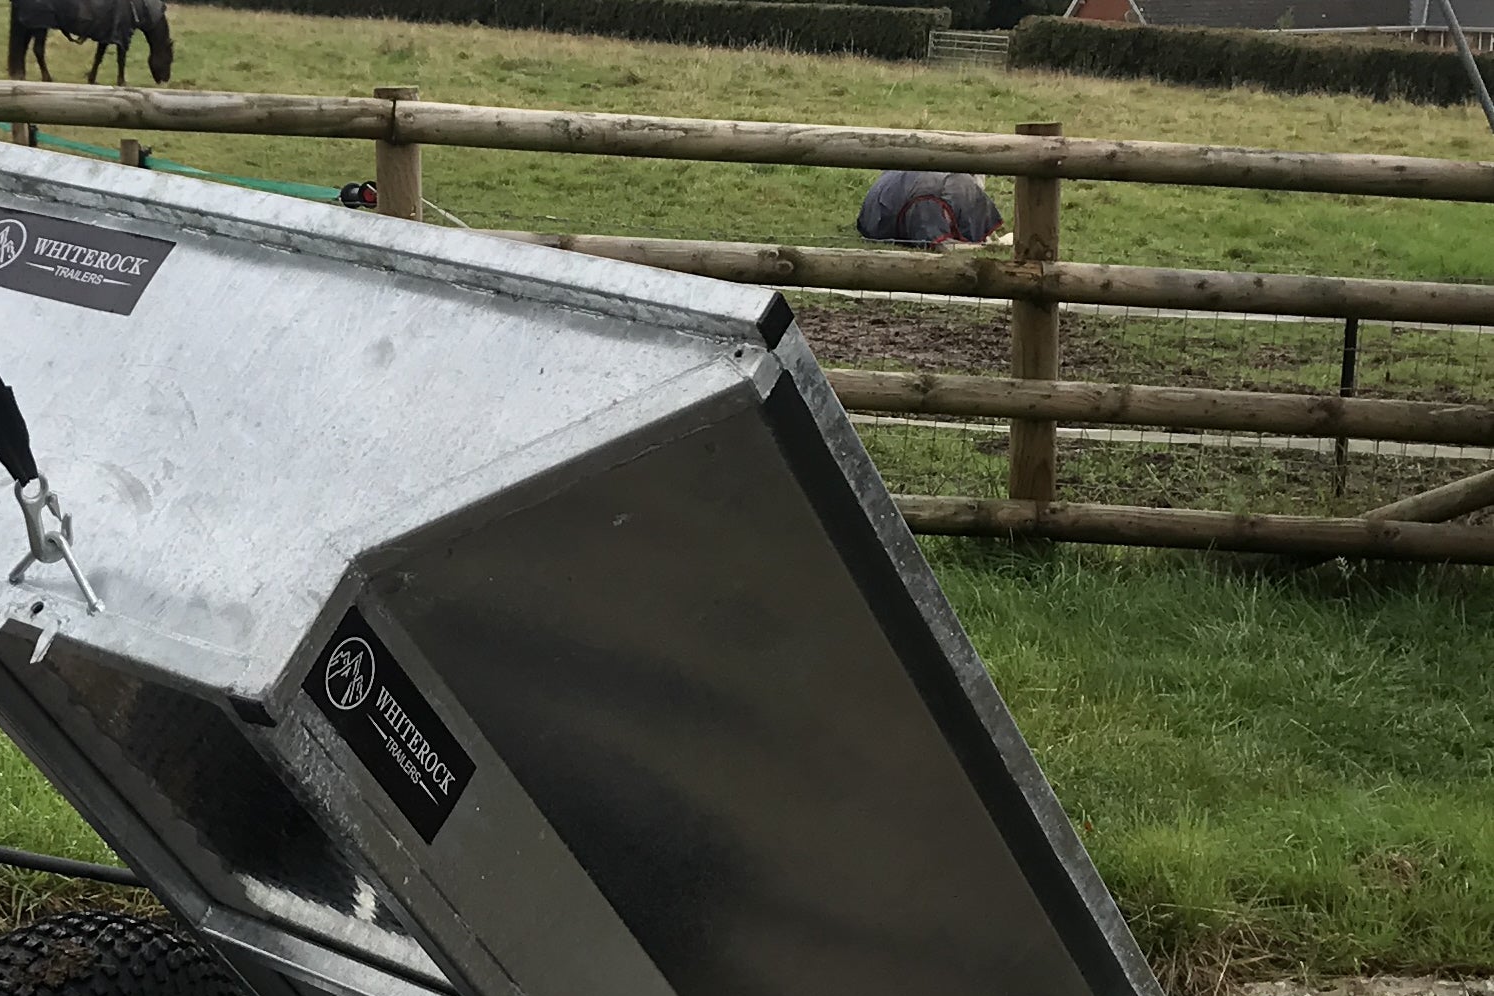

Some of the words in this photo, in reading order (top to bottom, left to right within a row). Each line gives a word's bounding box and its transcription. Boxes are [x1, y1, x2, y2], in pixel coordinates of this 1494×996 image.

[33, 237, 149, 275] WHITEROCK
[54, 265, 104, 285] TRAILERS
[375, 685, 456, 795] WHITEROCK
[385, 735, 422, 784] TRAILERS
